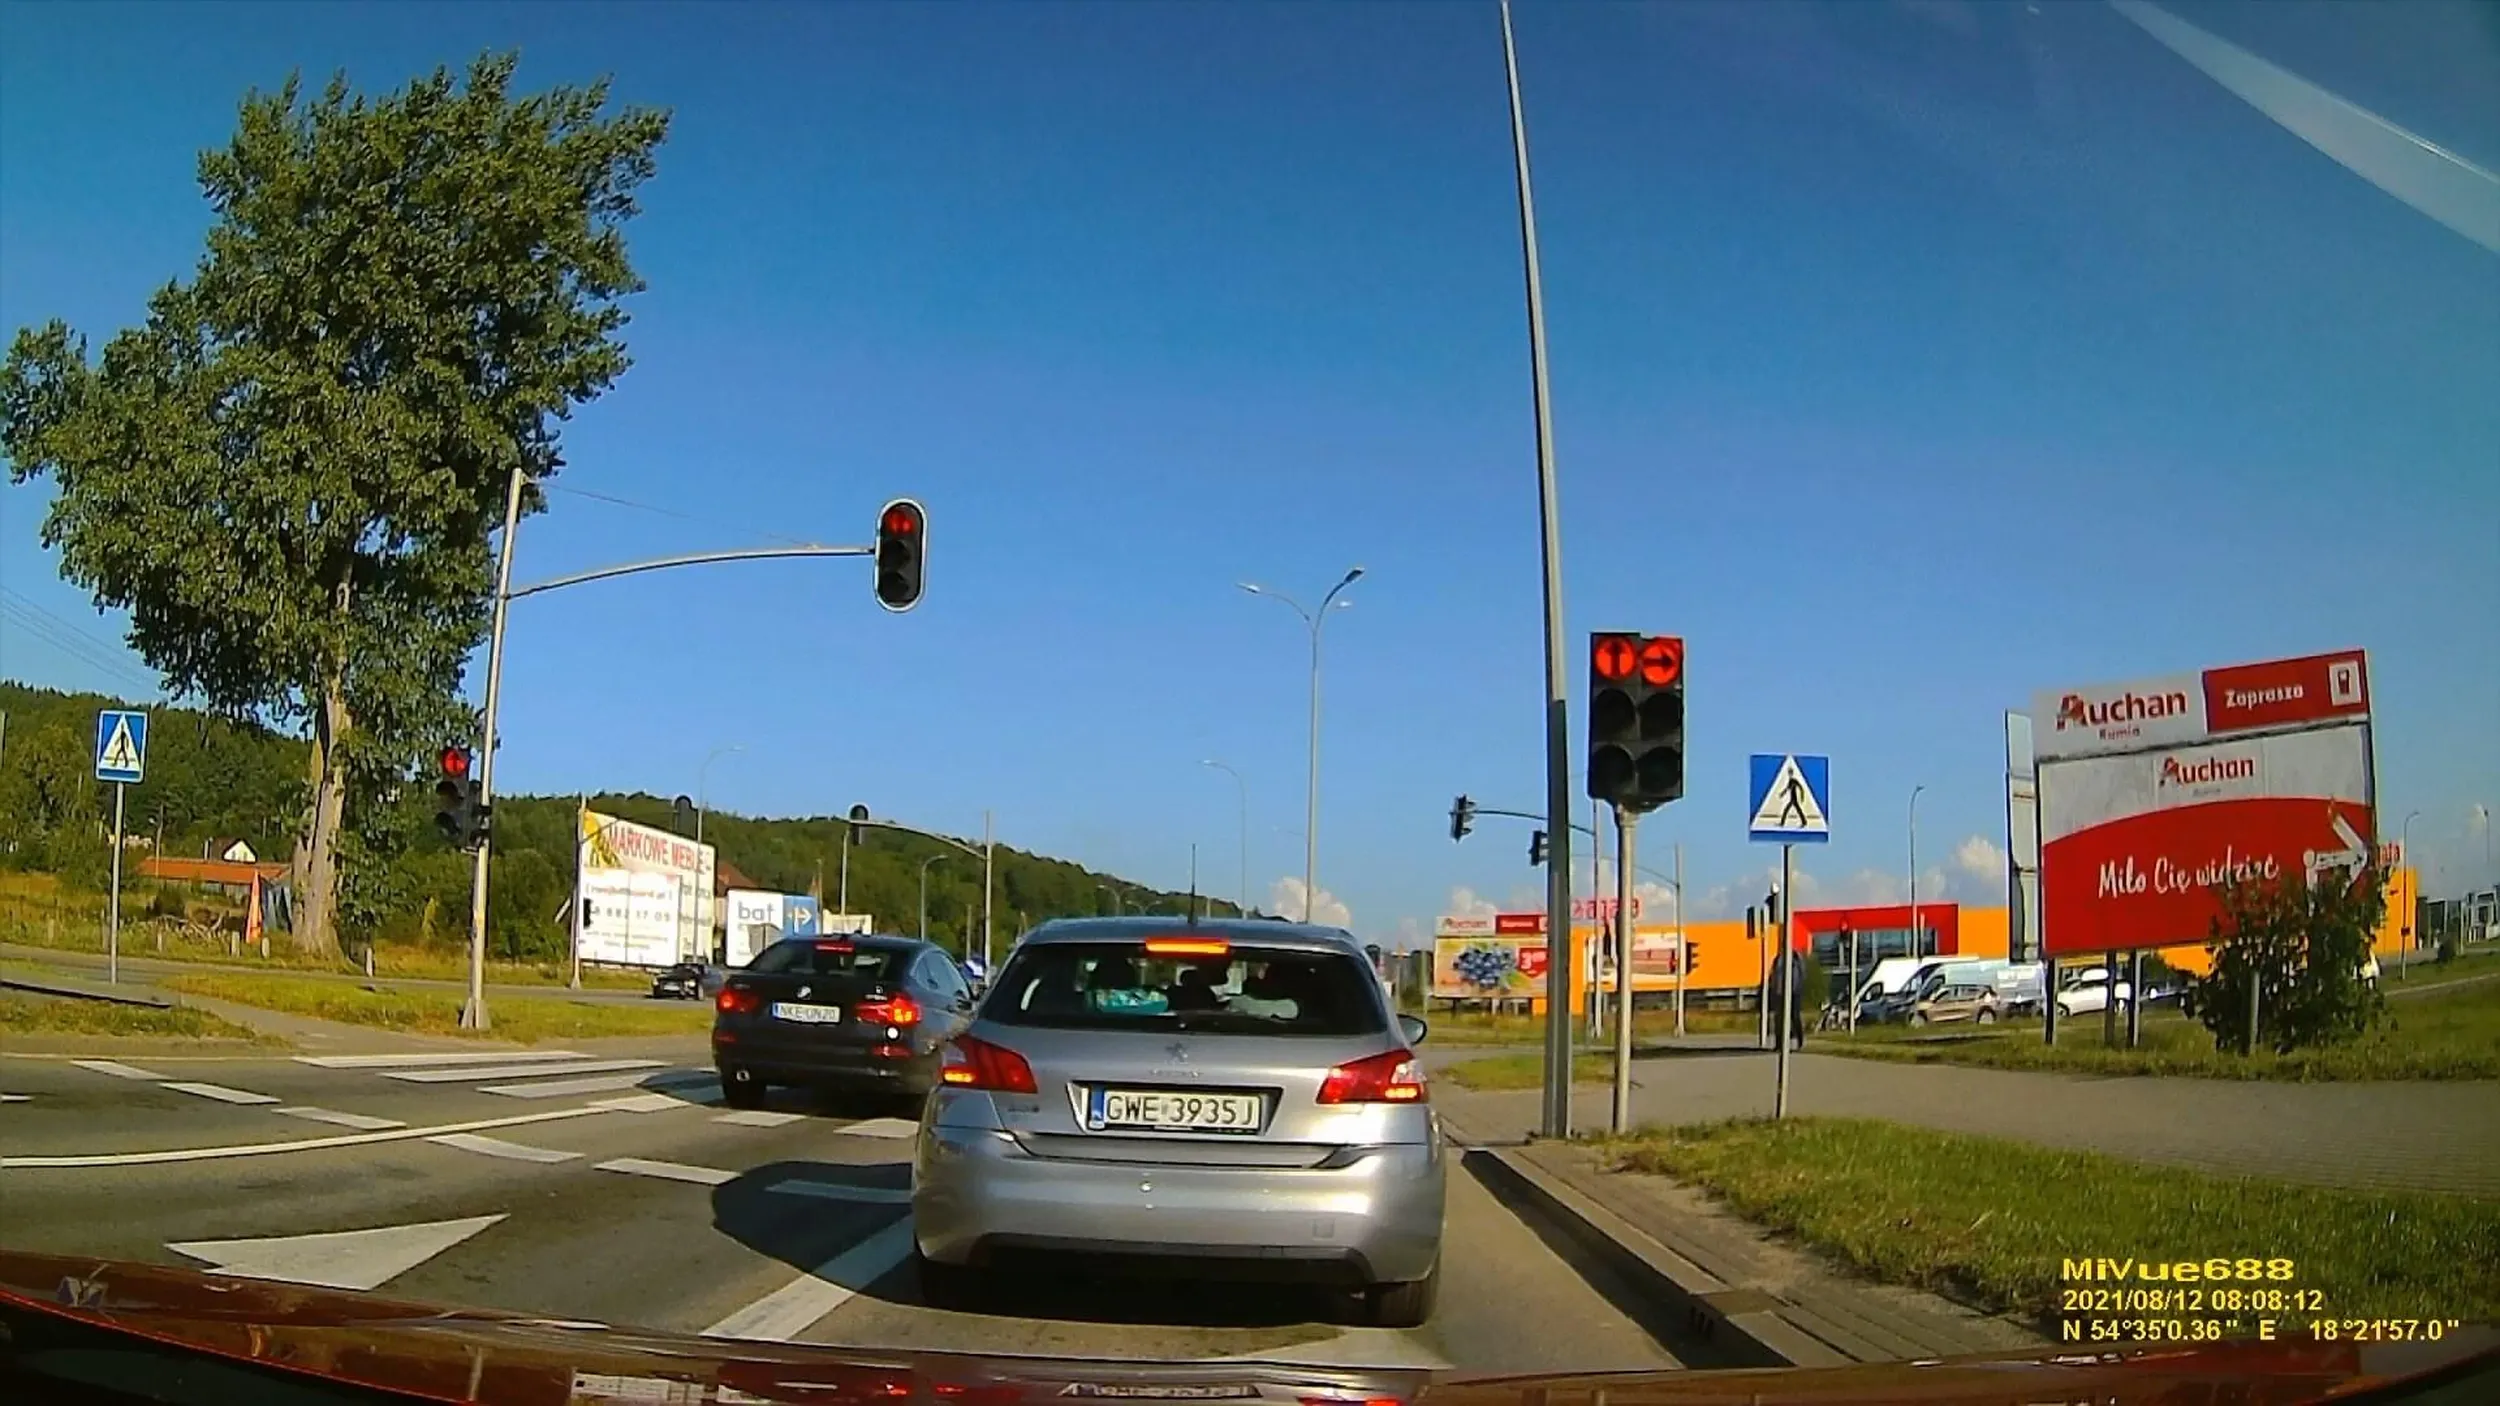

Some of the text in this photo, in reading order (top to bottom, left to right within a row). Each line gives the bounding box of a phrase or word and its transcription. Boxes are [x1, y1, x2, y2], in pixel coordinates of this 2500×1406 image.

[2055, 691, 2187, 730] Auchan
[2159, 756, 2255, 786] Auchan
[1107, 1095, 1253, 1125] GWE 3935J
